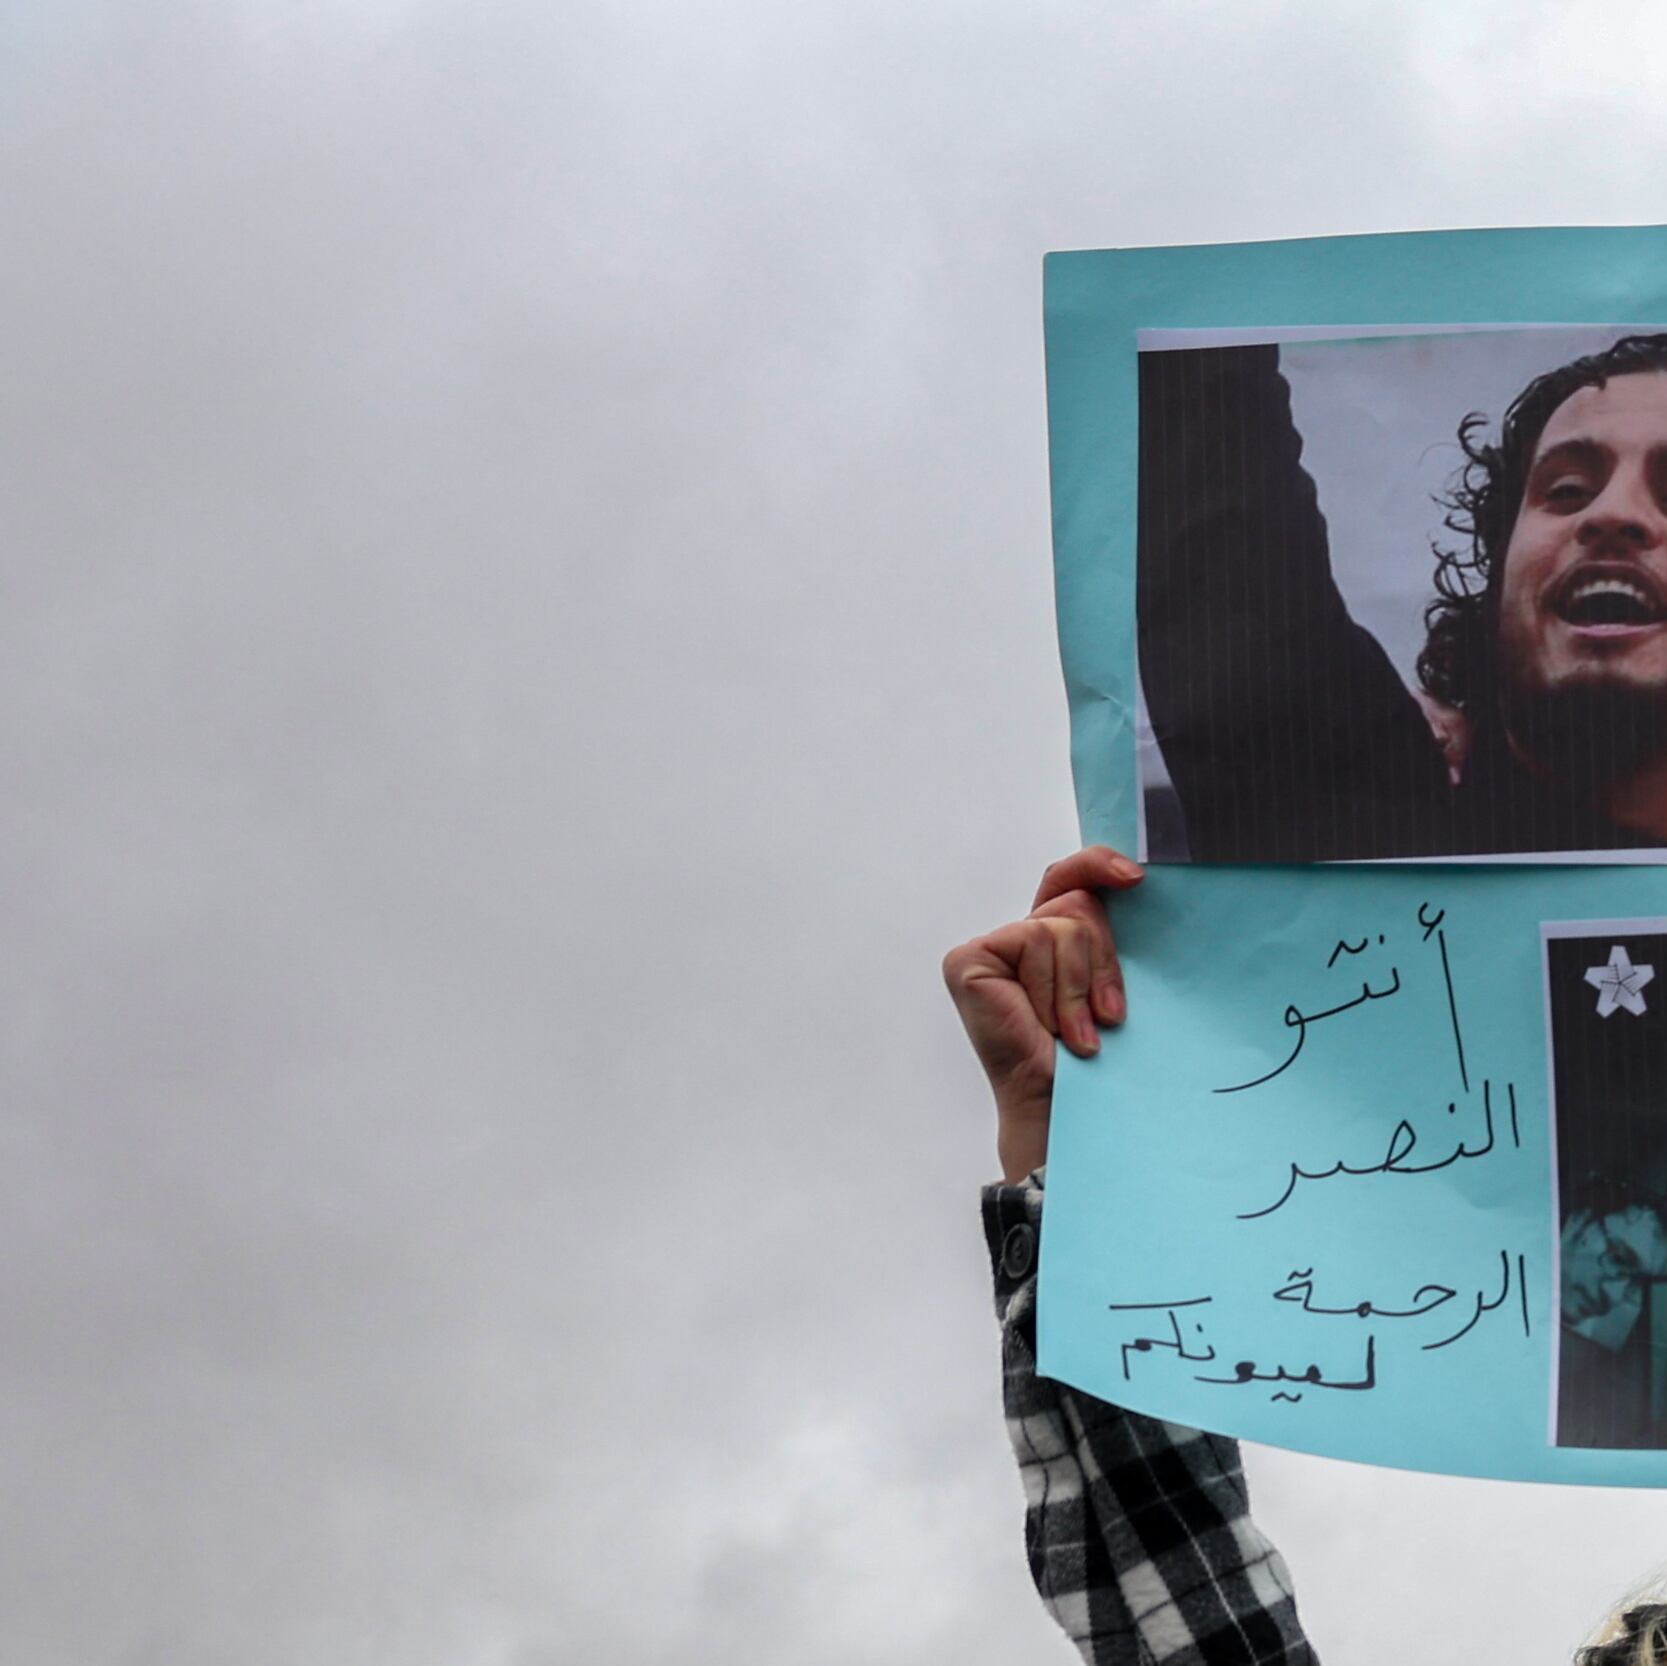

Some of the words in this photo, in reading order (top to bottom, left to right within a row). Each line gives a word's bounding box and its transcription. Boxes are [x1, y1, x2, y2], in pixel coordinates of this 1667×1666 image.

[1212, 902, 1470, 1093] أنتو
[1236, 1079, 1520, 1220] النصر
[1273, 1250, 1531, 1351] الرحمة
